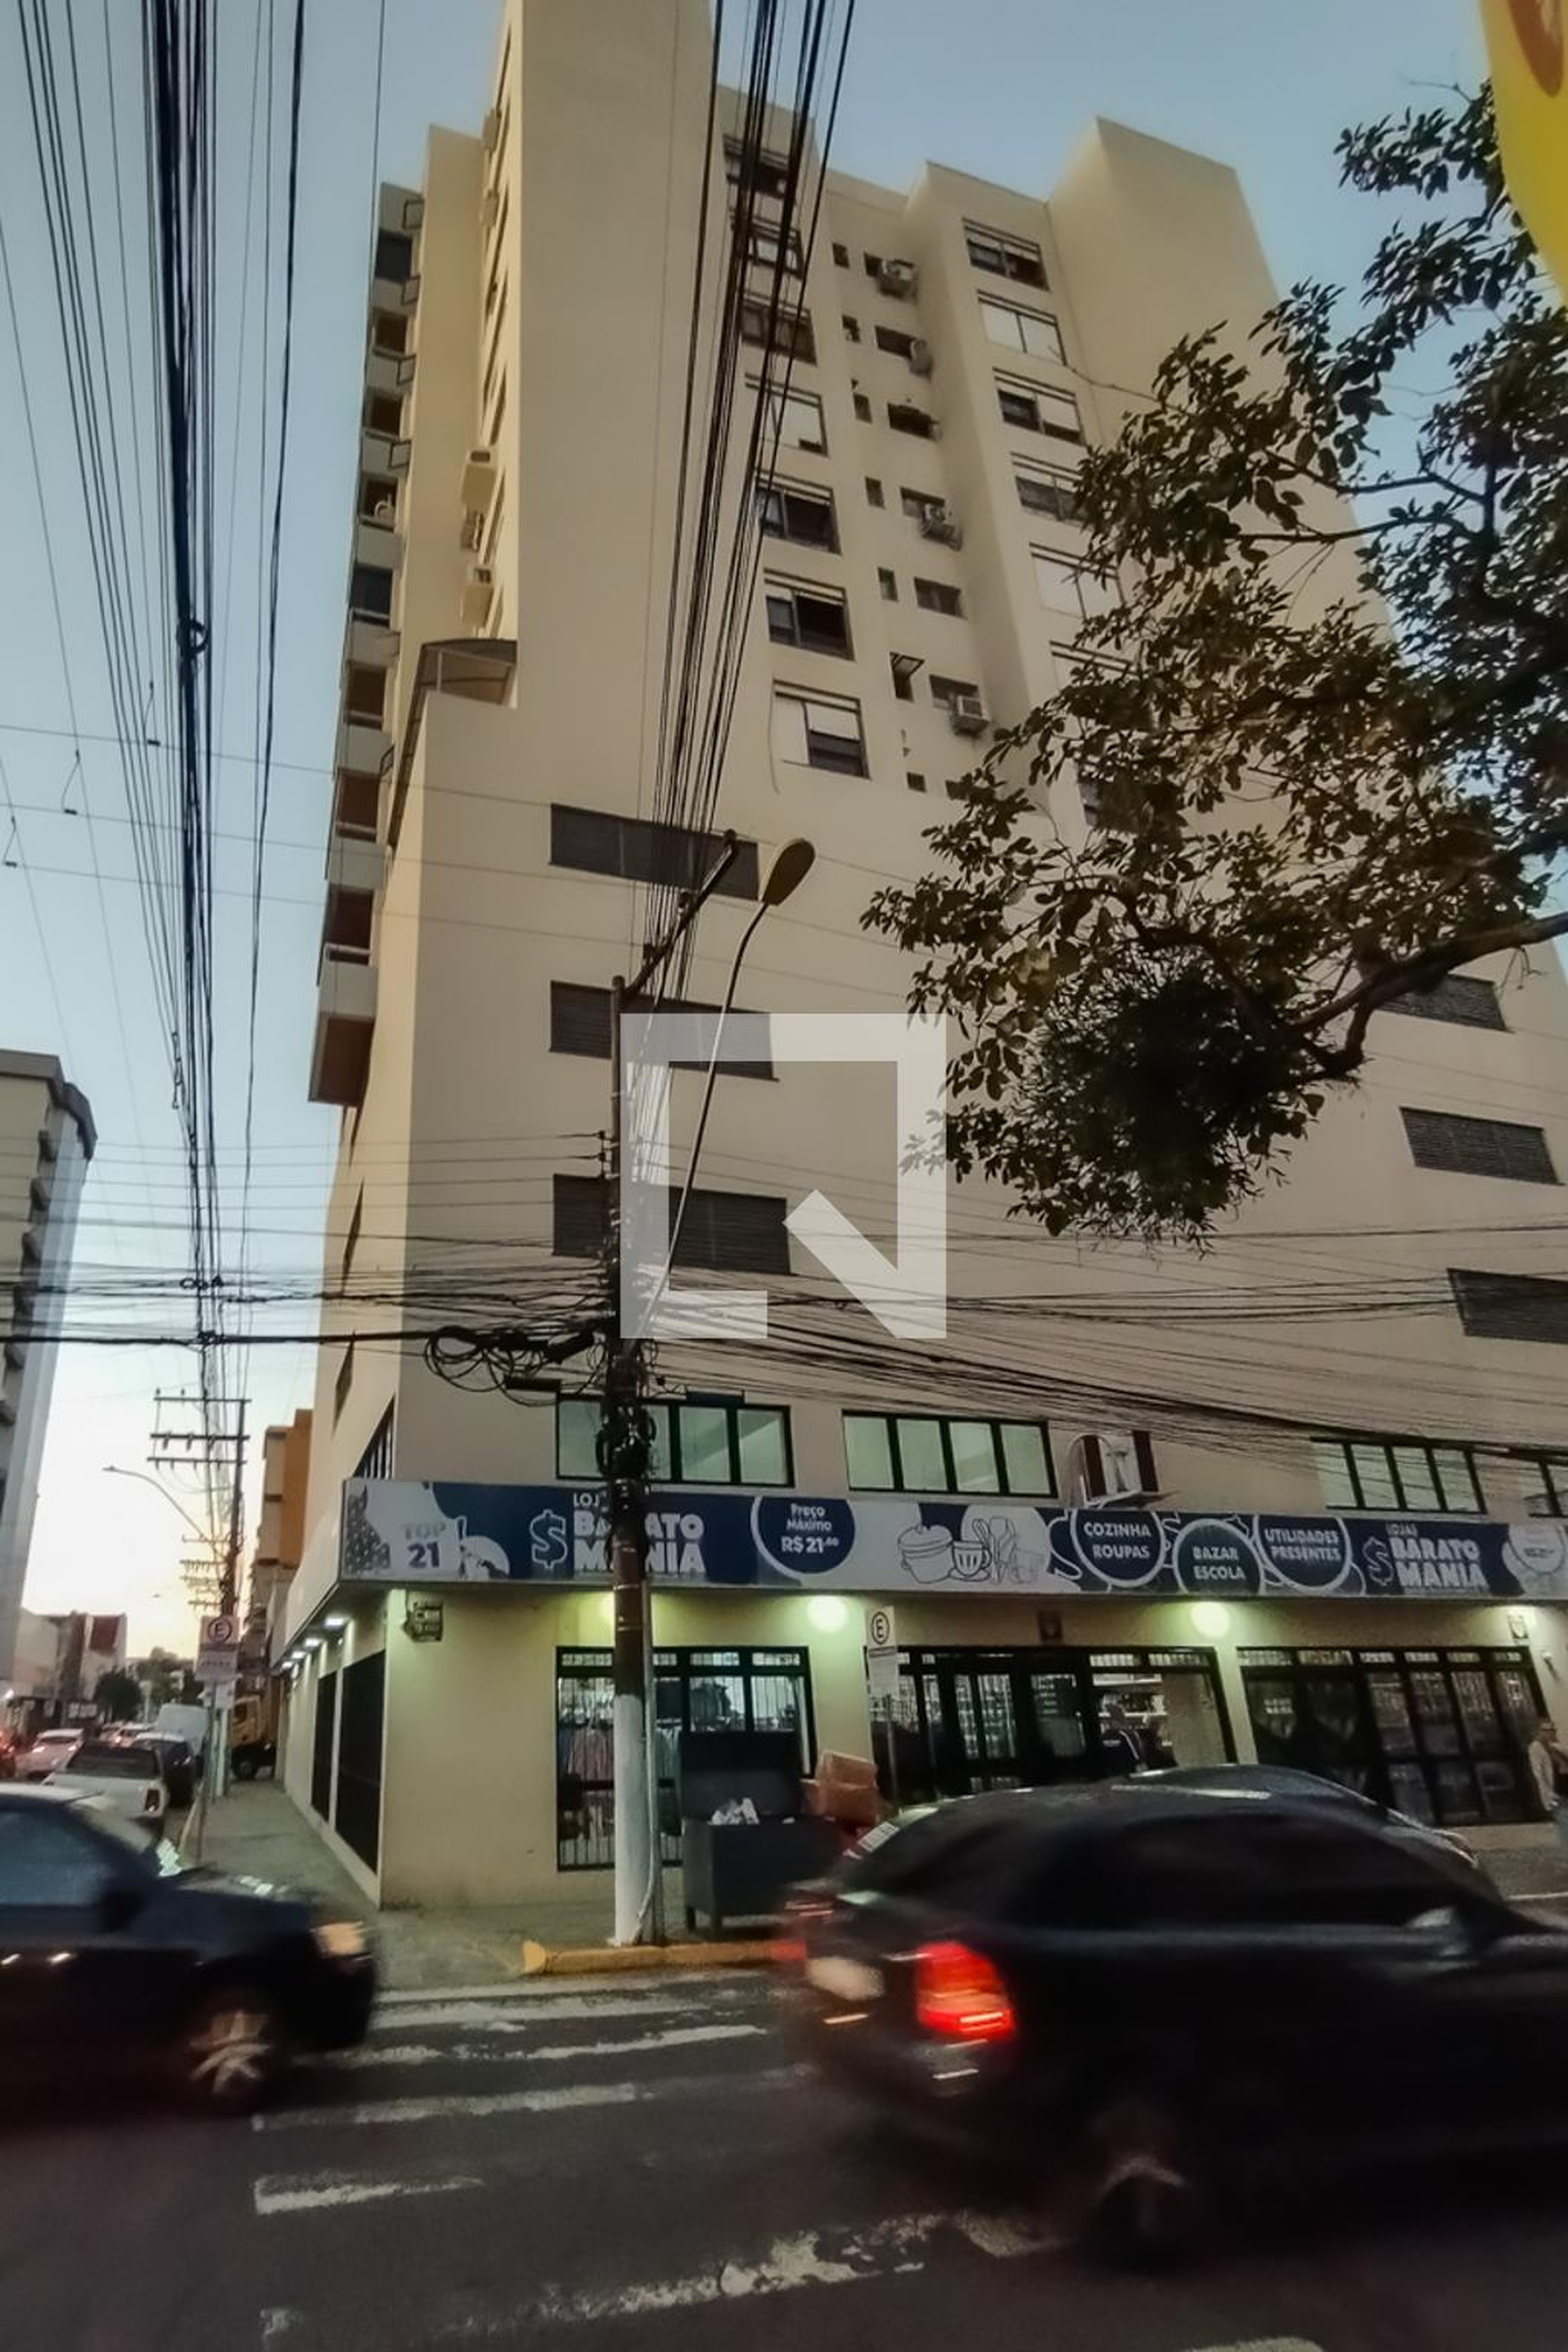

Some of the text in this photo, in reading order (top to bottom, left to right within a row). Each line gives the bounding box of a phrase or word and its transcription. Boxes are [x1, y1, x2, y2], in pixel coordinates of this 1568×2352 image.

[573, 1493, 599, 1508] LOJ
[791, 1503, 826, 1518] Preço
[573, 1510, 704, 1540] BAATO
[1084, 1522, 1152, 1537] COZINHA
[781, 1535, 804, 1553] R$
[1264, 1528, 1339, 1544] UTILIDADES
[407, 1541, 441, 1568] 21
[573, 1539, 706, 1573] MNIA
[1092, 1544, 1150, 1559] ROUPAS
[1193, 1546, 1239, 1561] BAZAR
[1270, 1546, 1342, 1561] PRESENTES
[1389, 1537, 1480, 1560] BARATO
[1193, 1565, 1246, 1580] ESCOLA
[1395, 1561, 1490, 1588] MANIA
[215, 1622, 225, 1638] E
[876, 1618, 884, 1638] E
